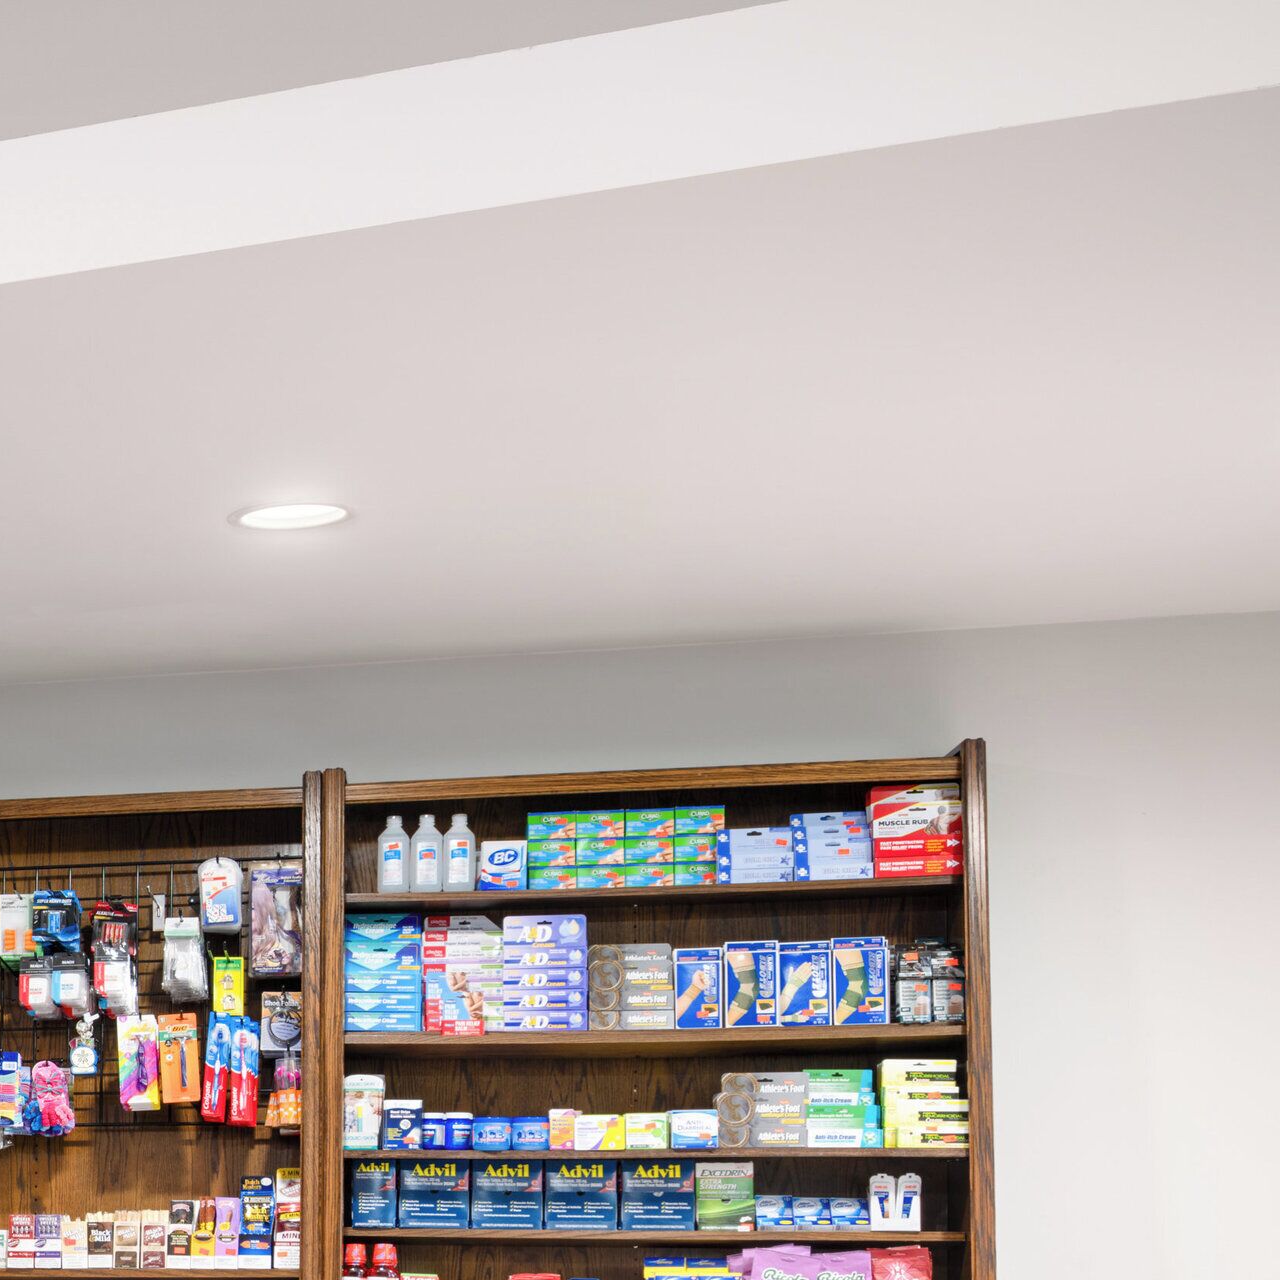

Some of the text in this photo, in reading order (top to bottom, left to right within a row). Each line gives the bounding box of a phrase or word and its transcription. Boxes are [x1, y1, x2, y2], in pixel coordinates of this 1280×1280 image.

[493, 850, 516, 865] BC
[626, 972, 653, 980] Athlete's
[627, 995, 667, 1004] Athlete's Foot
[655, 1015, 667, 1023] Foot
[760, 1083, 805, 1093] Athlete's Foot
[204, 1081, 212, 1109] Colgate
[755, 1104, 800, 1113] Athlete's Foot
[758, 1131, 799, 1141] Athlete's Foot
[357, 1163, 389, 1172] Advil
[412, 1163, 456, 1177] Advil
[484, 1164, 530, 1178] Advil
[558, 1165, 604, 1178] Advil
[634, 1165, 681, 1178] Advil
[700, 1169, 749, 1177] EXCEDRIN
